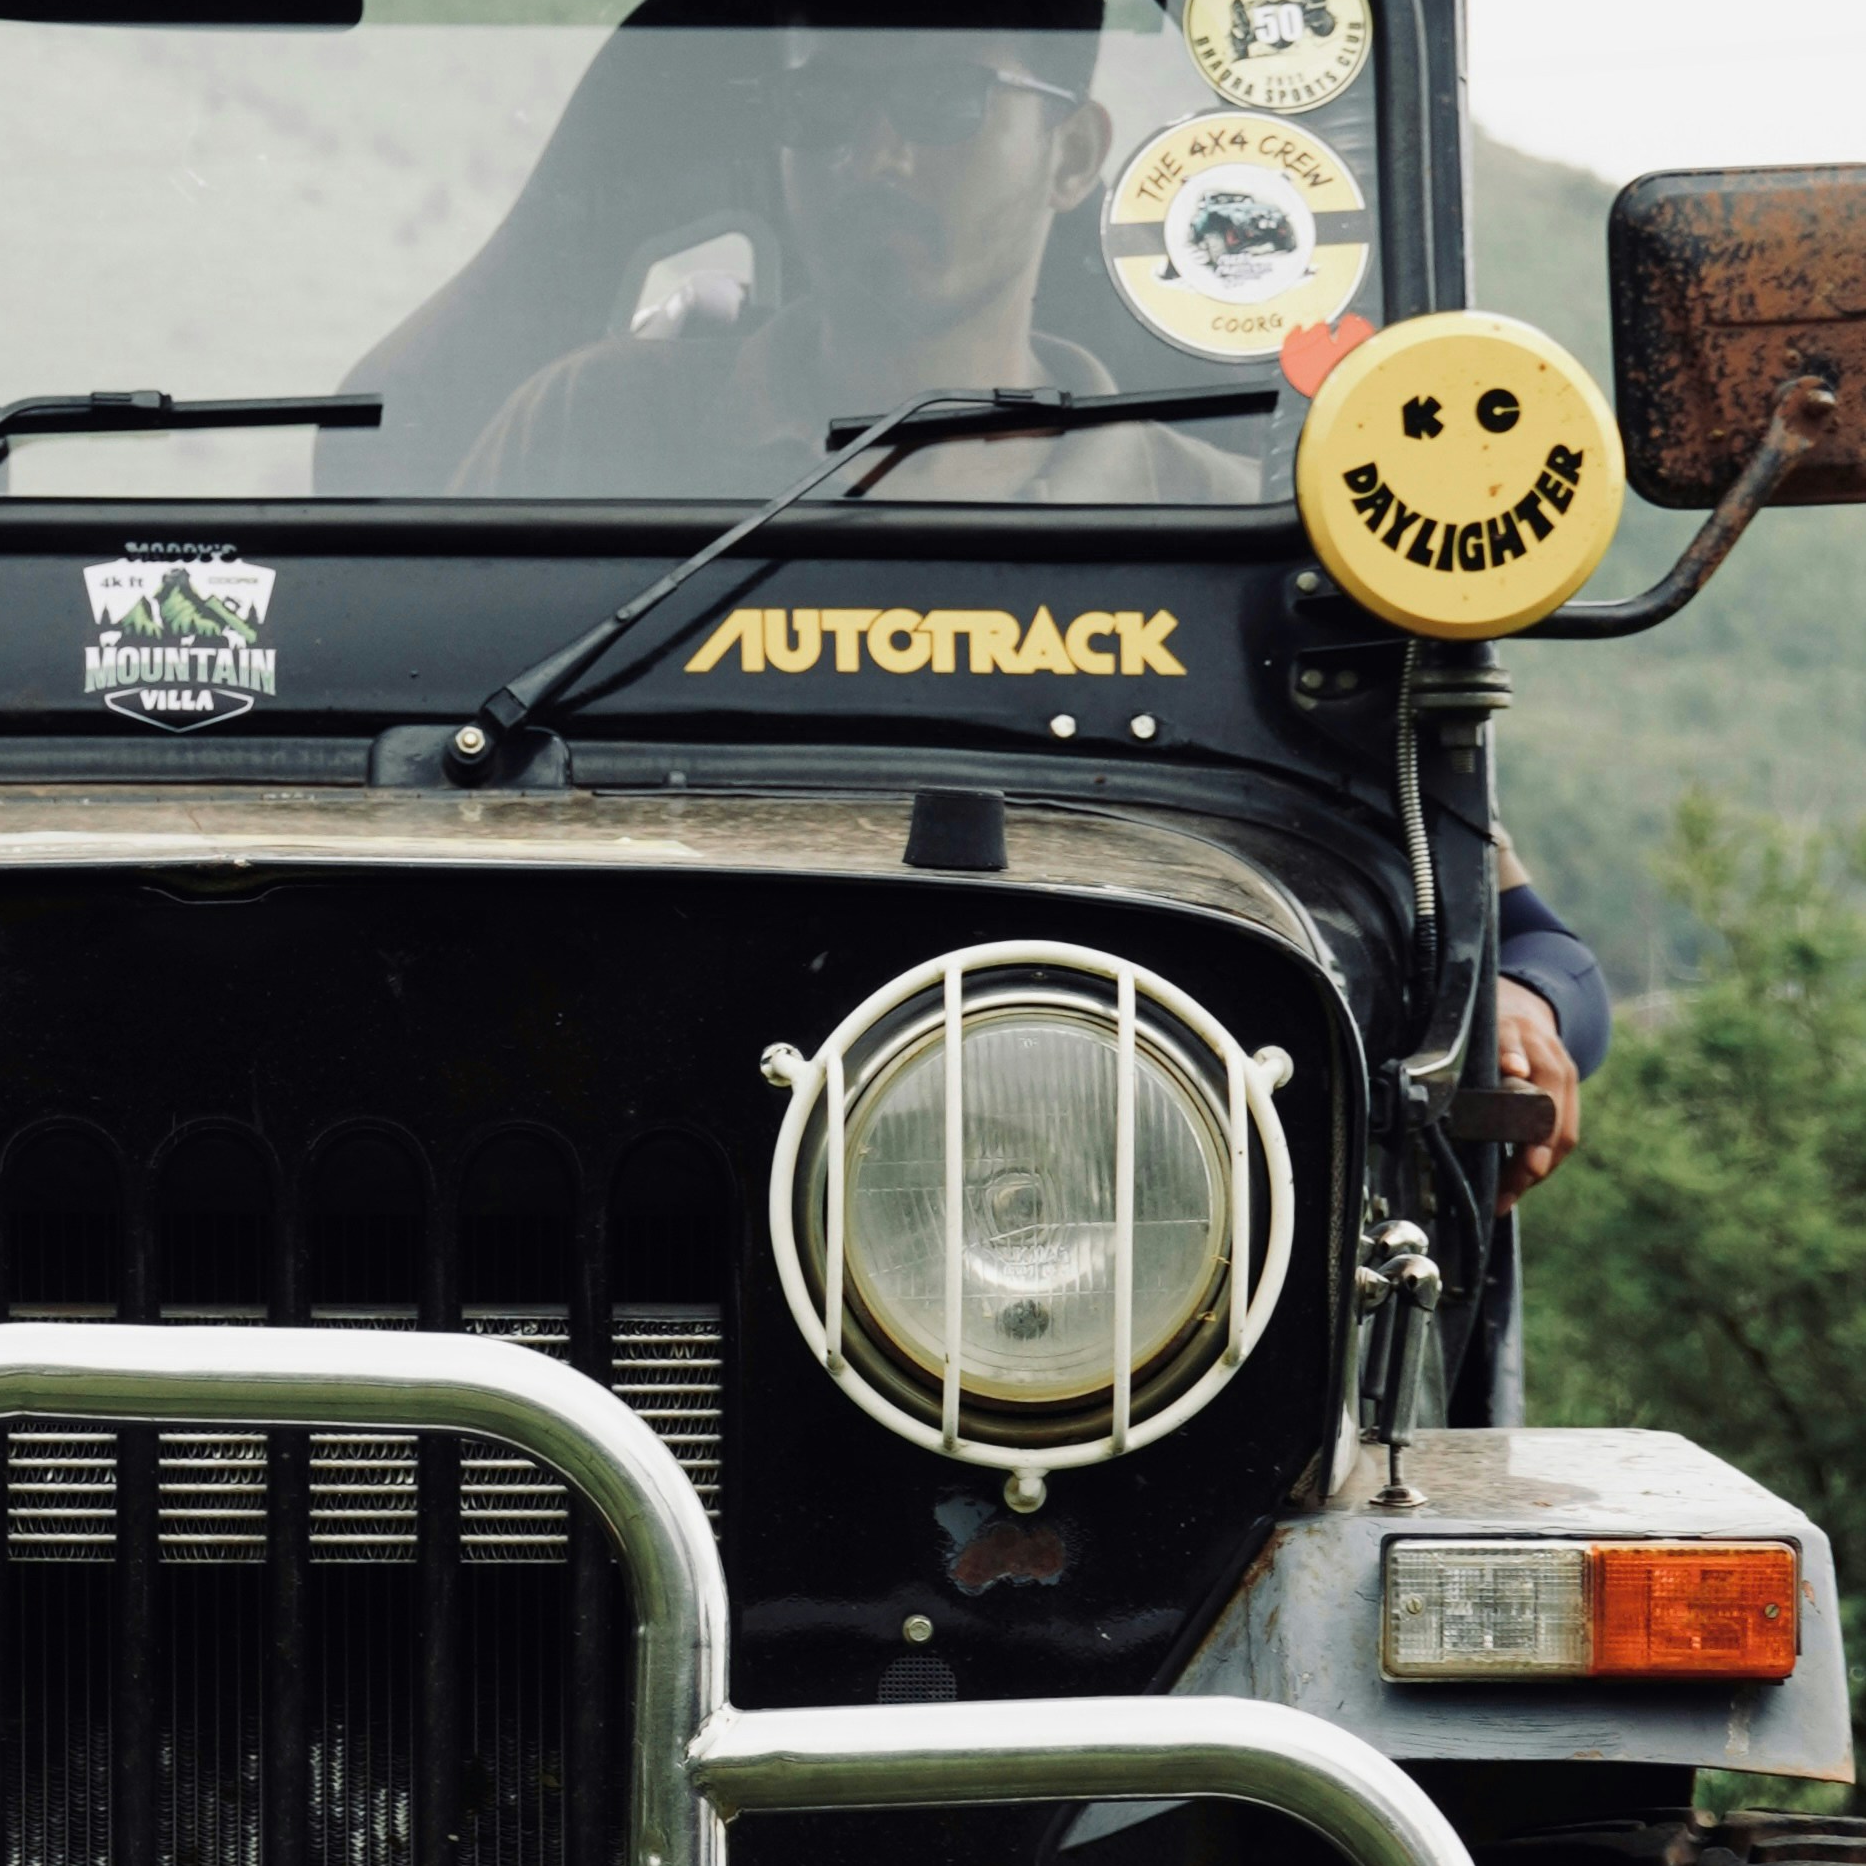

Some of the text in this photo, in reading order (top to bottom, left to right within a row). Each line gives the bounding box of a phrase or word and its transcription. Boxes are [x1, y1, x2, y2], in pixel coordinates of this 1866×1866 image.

[1252, 3, 1305, 44] 50
[1265, 71, 1338, 104] SPORTS
[1337, 21, 1364, 67] CLUB
[1137, 129, 1334, 202] THE 4X4 CREW
[1211, 312, 1284, 334] COORG
[1342, 443, 1584, 573] DAYLIGHTER
[83, 644, 277, 697] MOUNTAIN
[684, 604, 1188, 676] AUTOTRACK
[139, 688, 215, 712] VILLA
